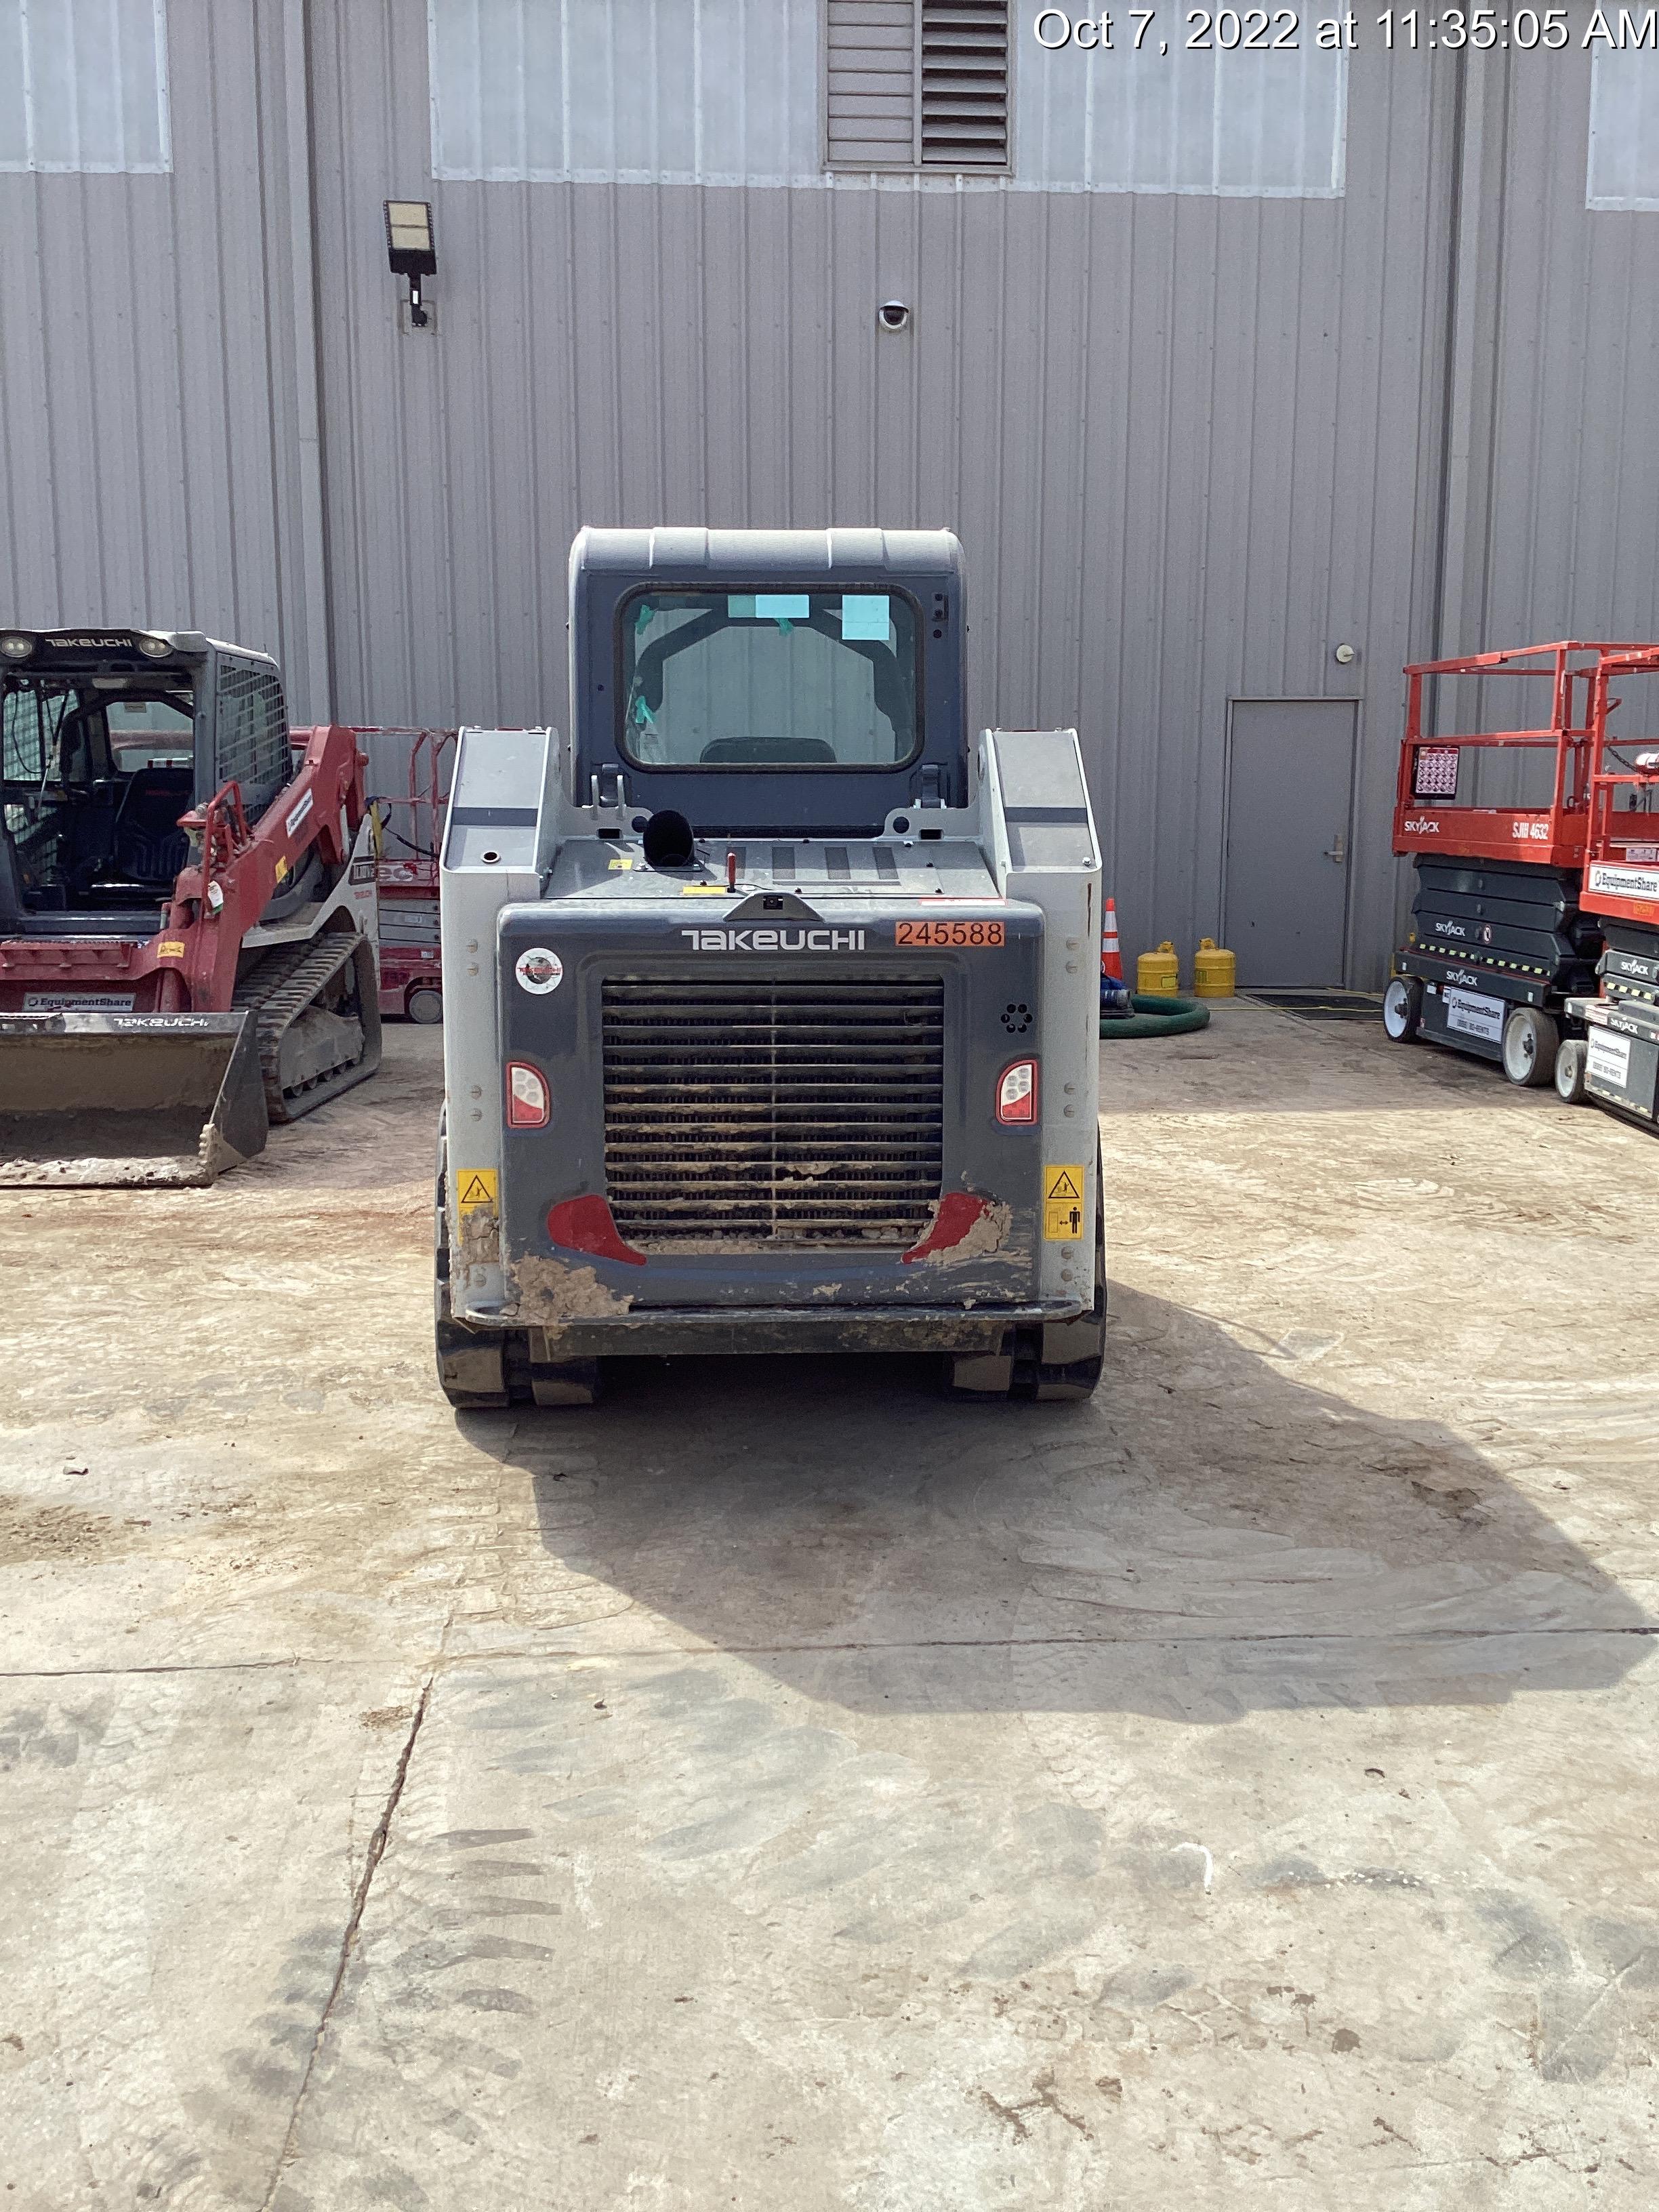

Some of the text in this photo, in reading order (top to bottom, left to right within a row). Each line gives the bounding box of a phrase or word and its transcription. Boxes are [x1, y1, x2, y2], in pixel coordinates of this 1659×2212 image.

[45, 639, 132, 647] TAKEUCHI
[1404, 815, 1439, 834] SKYJACK
[1530, 823, 1549, 840] 4632
[1602, 872, 1658, 893] EquipmentShare
[897, 922, 1002, 945] 245588
[1435, 920, 1466, 937] SKYJACK
[681, 930, 865, 950] TAKEUCHI
[1621, 959, 1649, 976] SKYJACK
[1446, 969, 1478, 987] SKYJACK
